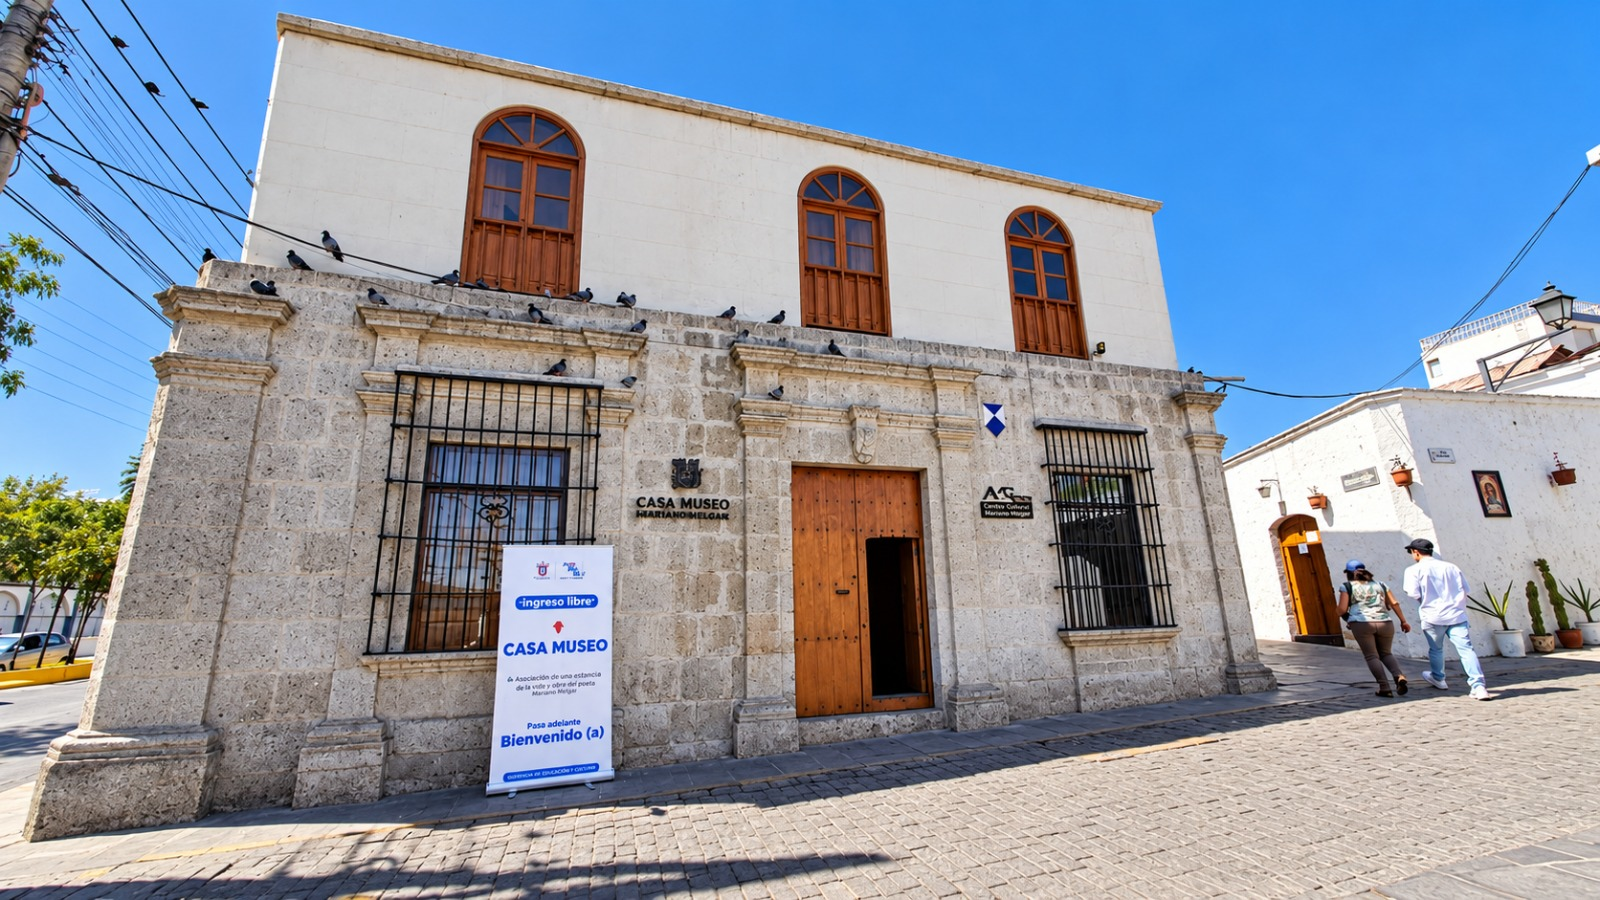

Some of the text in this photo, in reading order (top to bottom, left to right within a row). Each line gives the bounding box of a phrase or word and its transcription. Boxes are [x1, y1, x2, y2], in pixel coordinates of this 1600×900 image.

[636, 496, 730, 510] CASA MUSEO
[503, 639, 608, 656] CASA MUSEO
[547, 718, 581, 728] adelante
[500, 726, 604, 748] Bienvenido (a)
